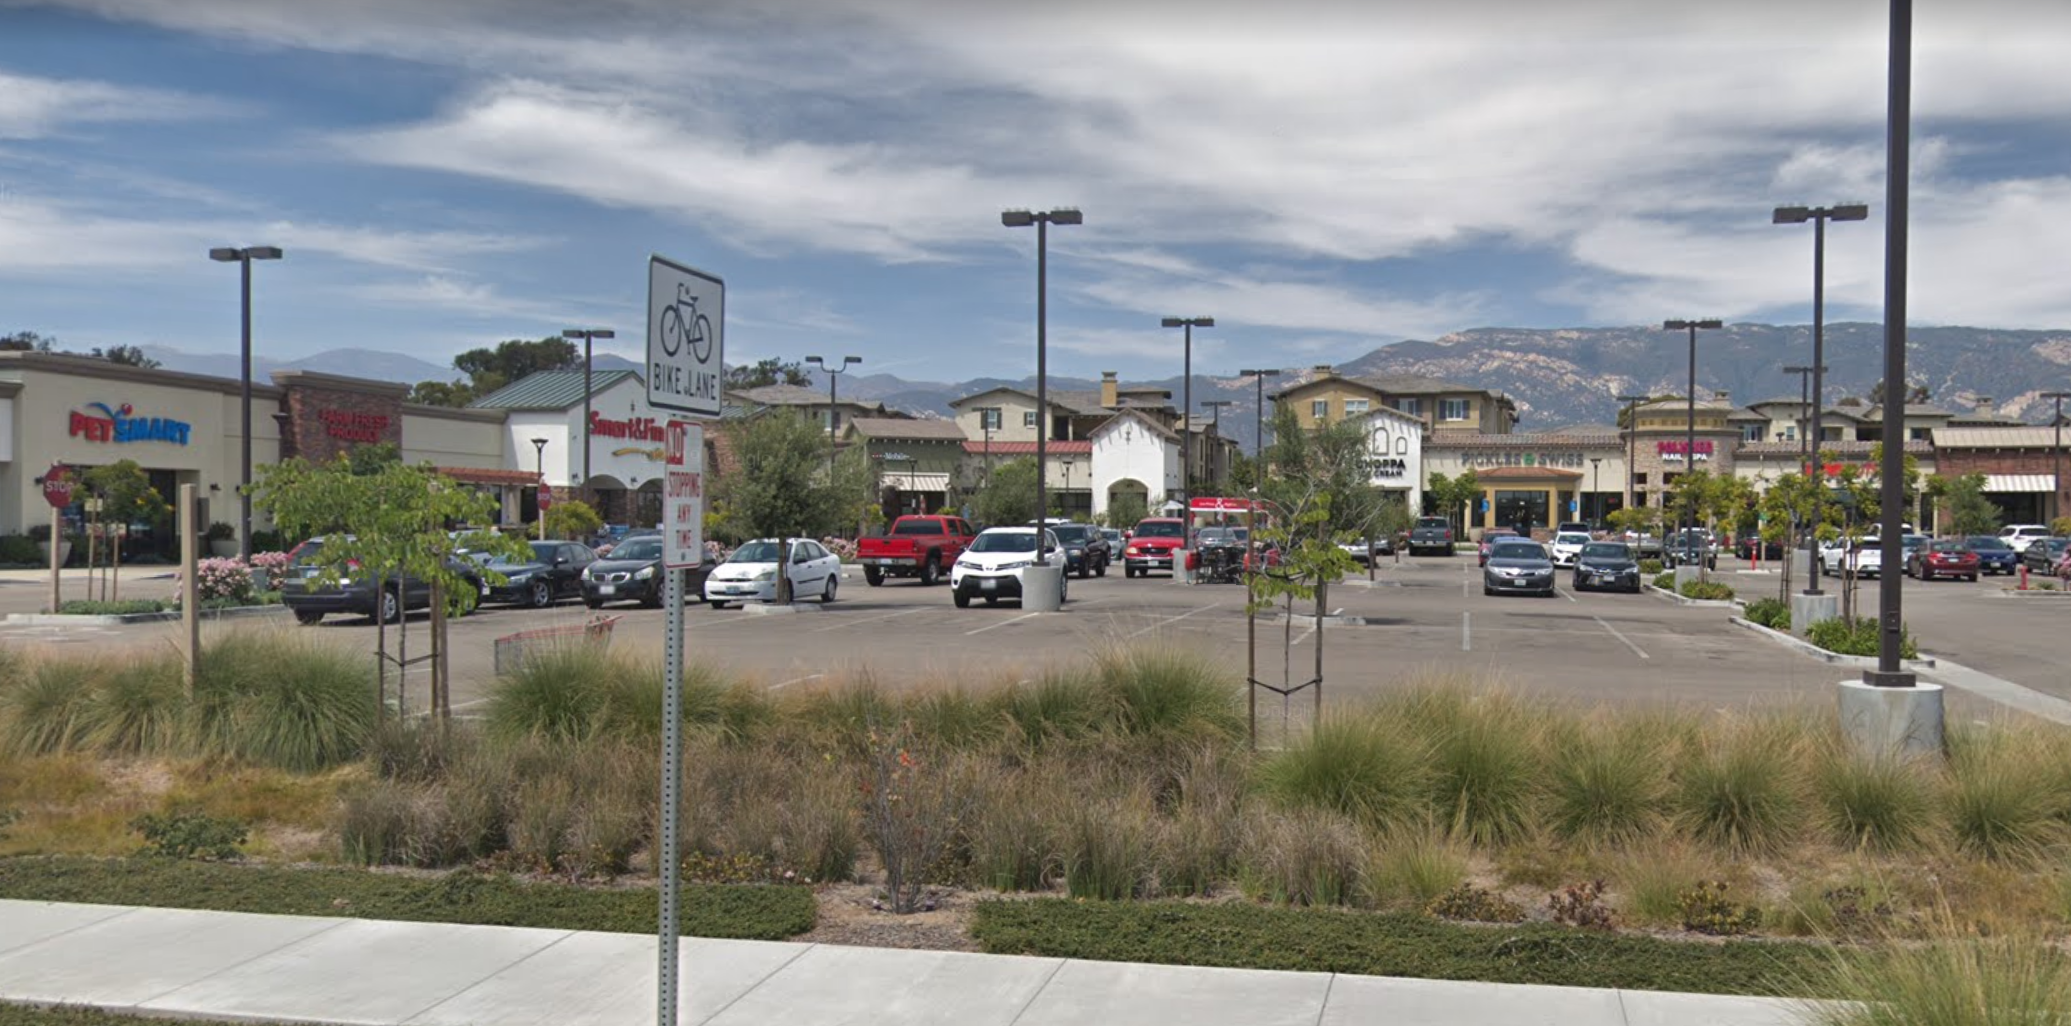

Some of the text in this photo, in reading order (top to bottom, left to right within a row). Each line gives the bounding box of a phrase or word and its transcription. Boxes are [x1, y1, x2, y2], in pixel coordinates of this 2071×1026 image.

[653, 362, 717, 401] BIKE LANE
[69, 408, 191, 446] PETSMART
[328, 426, 381, 442] PRODUCE
[668, 426, 682, 458] NO
[1461, 453, 1584, 467] PICKLES & SWISS
[1662, 453, 1682, 461] NAIL
[668, 471, 700, 497] STOPPING
[1374, 469, 1403, 478] CREAM
[677, 503, 692, 524] ANY
[676, 529, 692, 550] TIME
